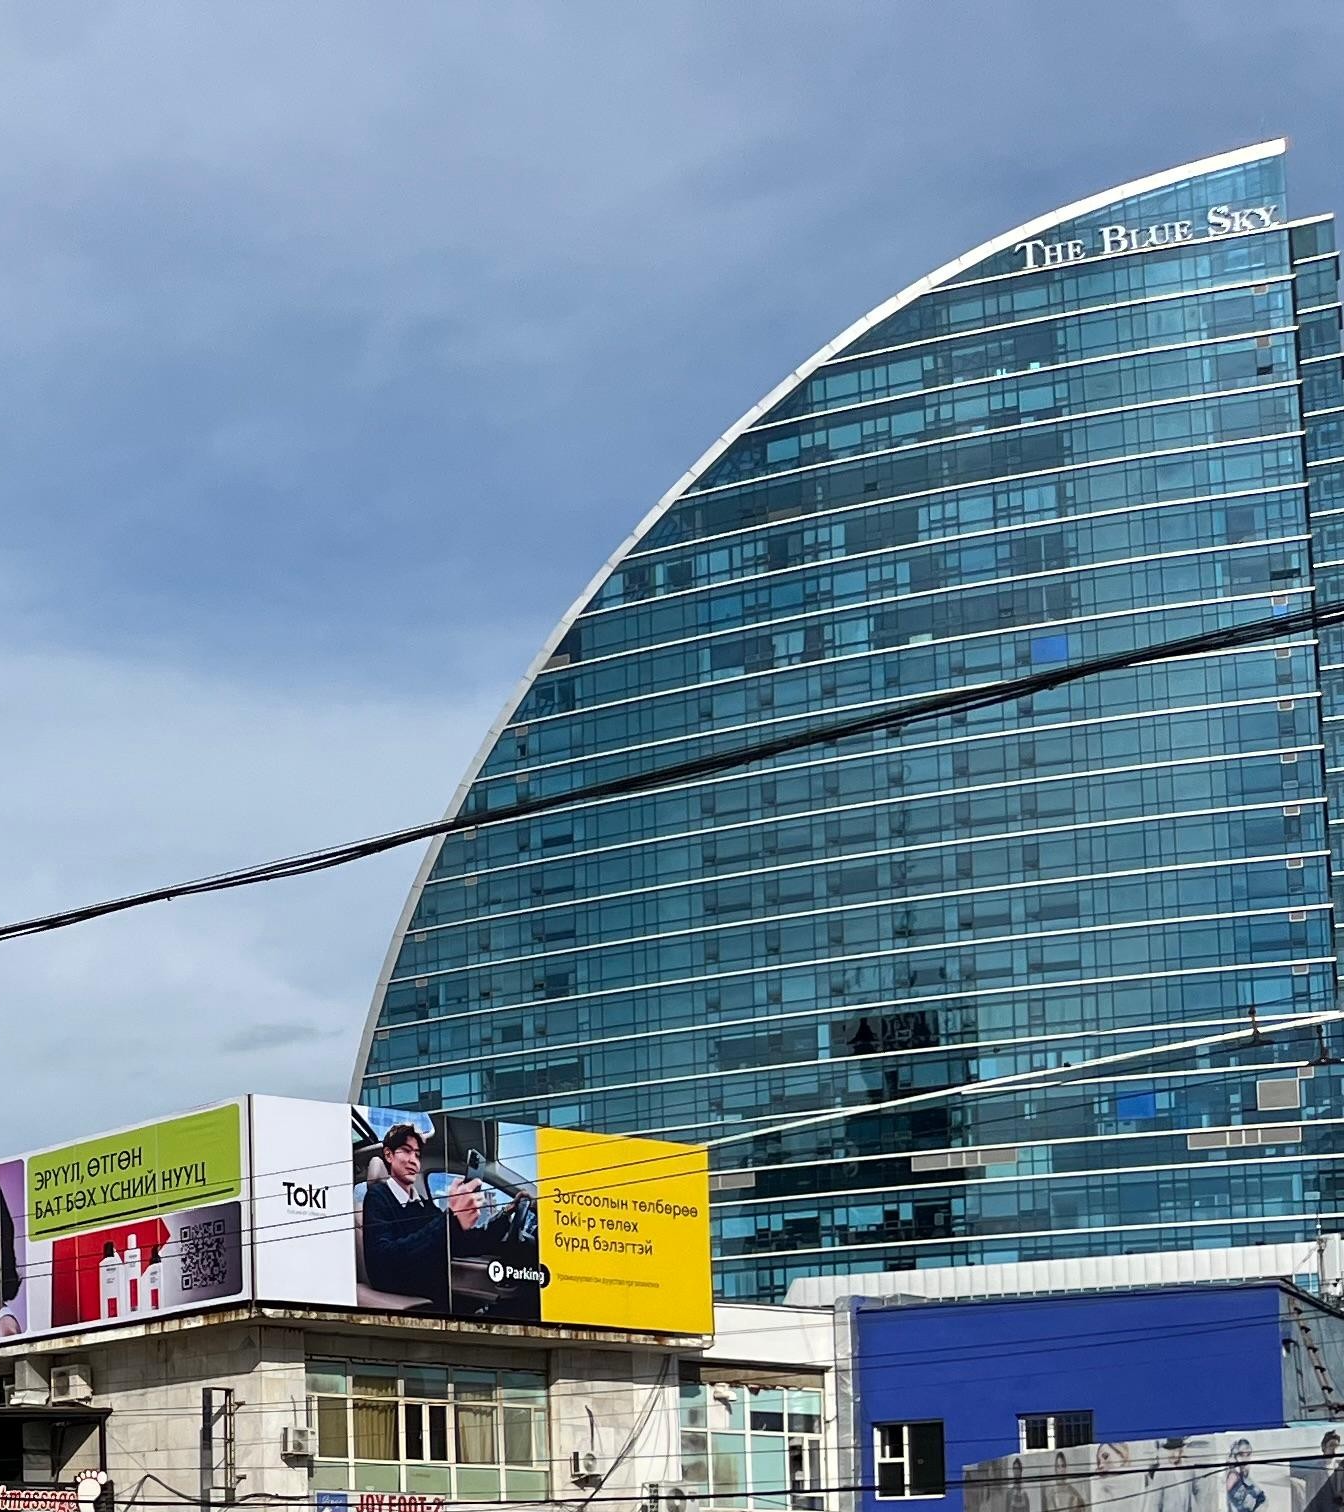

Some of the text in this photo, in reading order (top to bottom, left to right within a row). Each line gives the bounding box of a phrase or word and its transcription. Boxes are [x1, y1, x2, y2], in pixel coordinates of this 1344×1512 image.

[34, 1147, 142, 1191] ЭРҮҮЛ, ӨТГӨН
[35, 1161, 206, 1219] БАТ БӨХ ҮСНИЙ НУУЦ
[283, 1181, 329, 1209] Toki
[553, 1188, 698, 1220] Зогсоолын төлбөрөө
[599, 1218, 639, 1234] төлөх
[554, 1232, 653, 1256] бүрд бэлэгтэй
[505, 1266, 545, 1285] Parking
